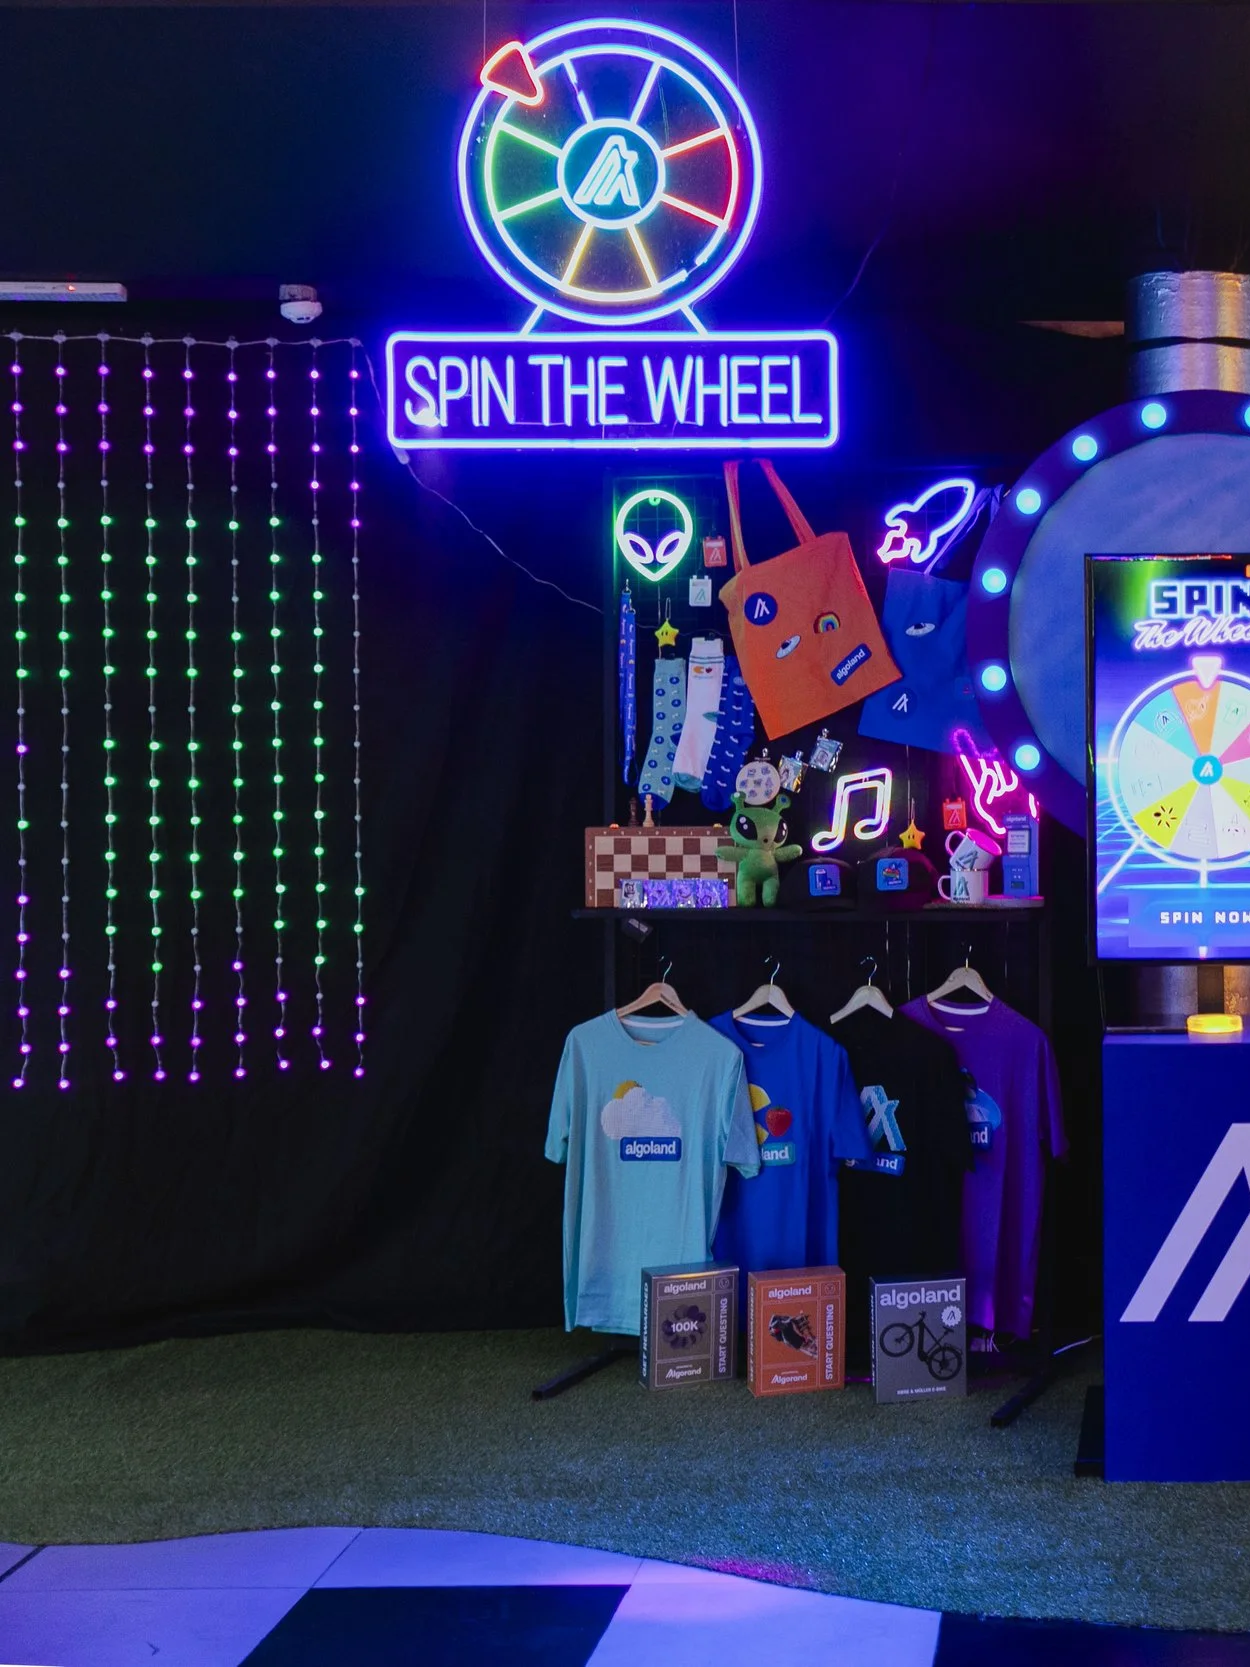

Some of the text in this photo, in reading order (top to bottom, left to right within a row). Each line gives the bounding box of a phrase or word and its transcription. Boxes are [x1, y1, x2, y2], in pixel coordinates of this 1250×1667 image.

[404, 355, 823, 427] SPIN THE WHEEL
[1133, 619, 1182, 650] The
[836, 648, 866, 680] algoland
[1160, 911, 1203, 924] SPIN
[625, 1140, 677, 1158] algoland
[664, 1279, 707, 1295] algoland
[768, 1285, 812, 1300] algoland
[879, 1284, 961, 1310] algoland
[670, 1320, 699, 1333] 100K
[718, 1298, 728, 1373] START QUESTING
[825, 1304, 834, 1380] START QUESTING
[665, 1367, 702, 1380] Algorand
[771, 1373, 808, 1385] Algorand
